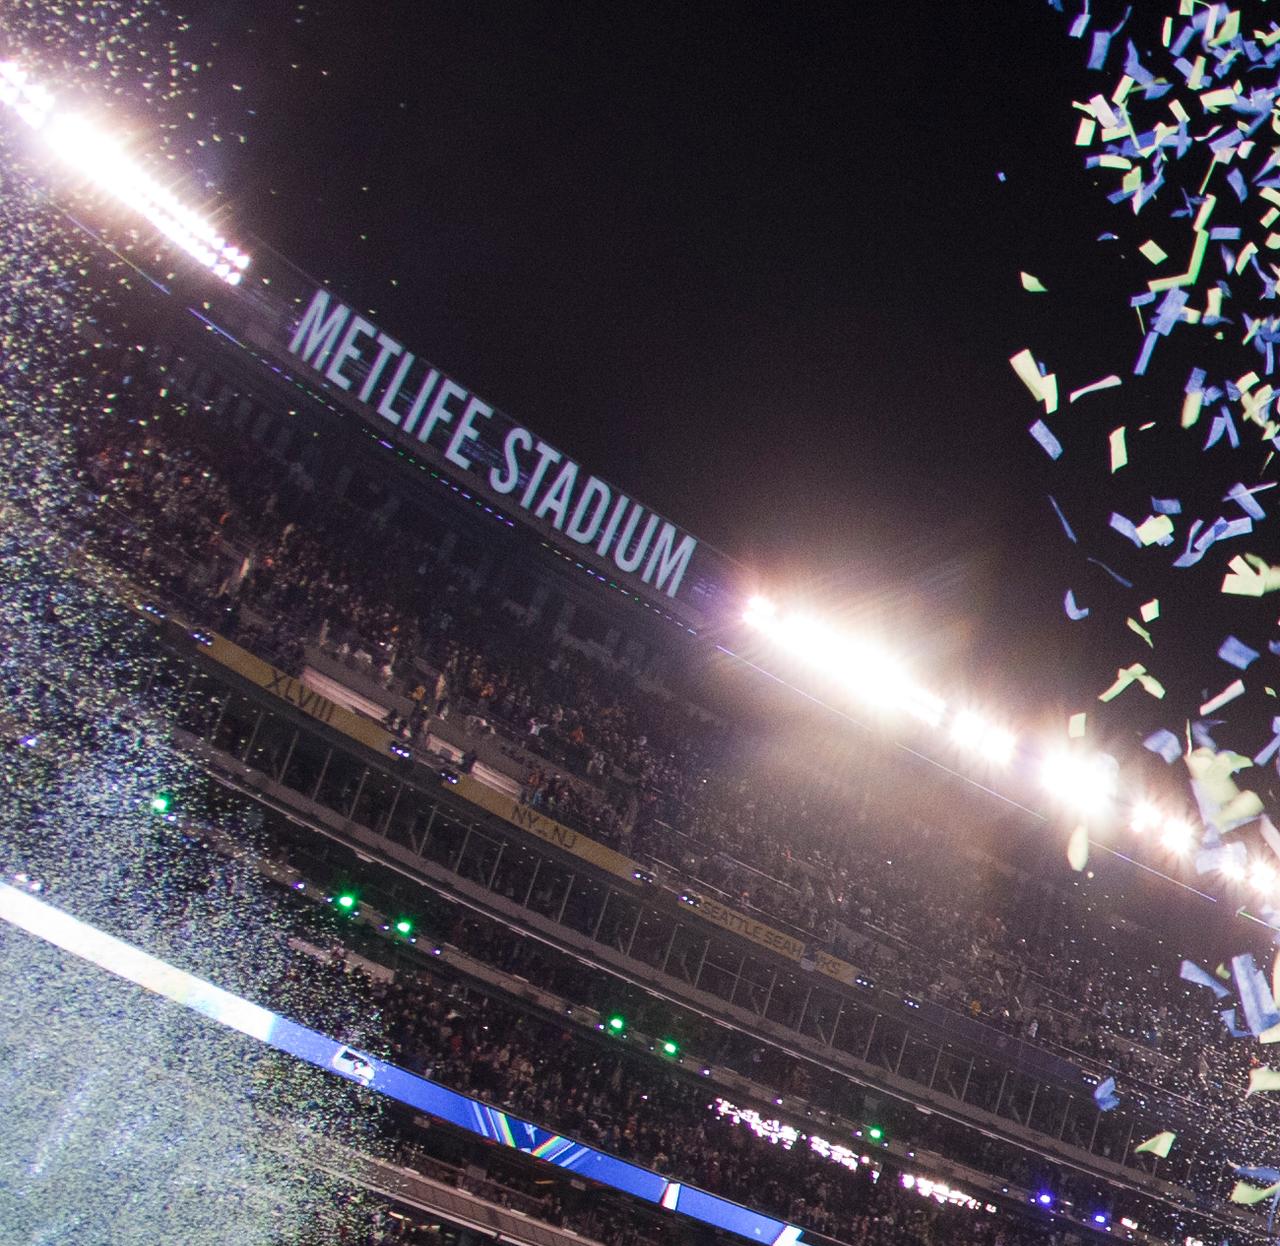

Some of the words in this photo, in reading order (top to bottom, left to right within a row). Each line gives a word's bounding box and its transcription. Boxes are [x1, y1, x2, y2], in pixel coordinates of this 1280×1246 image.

[289, 289, 494, 470] METLIFE
[489, 427, 697, 598] STADIUM
[264, 669, 336, 722] XLVIII
[702, 901, 761, 936] SEATTLE
[763, 928, 842, 975] SEAHKS
